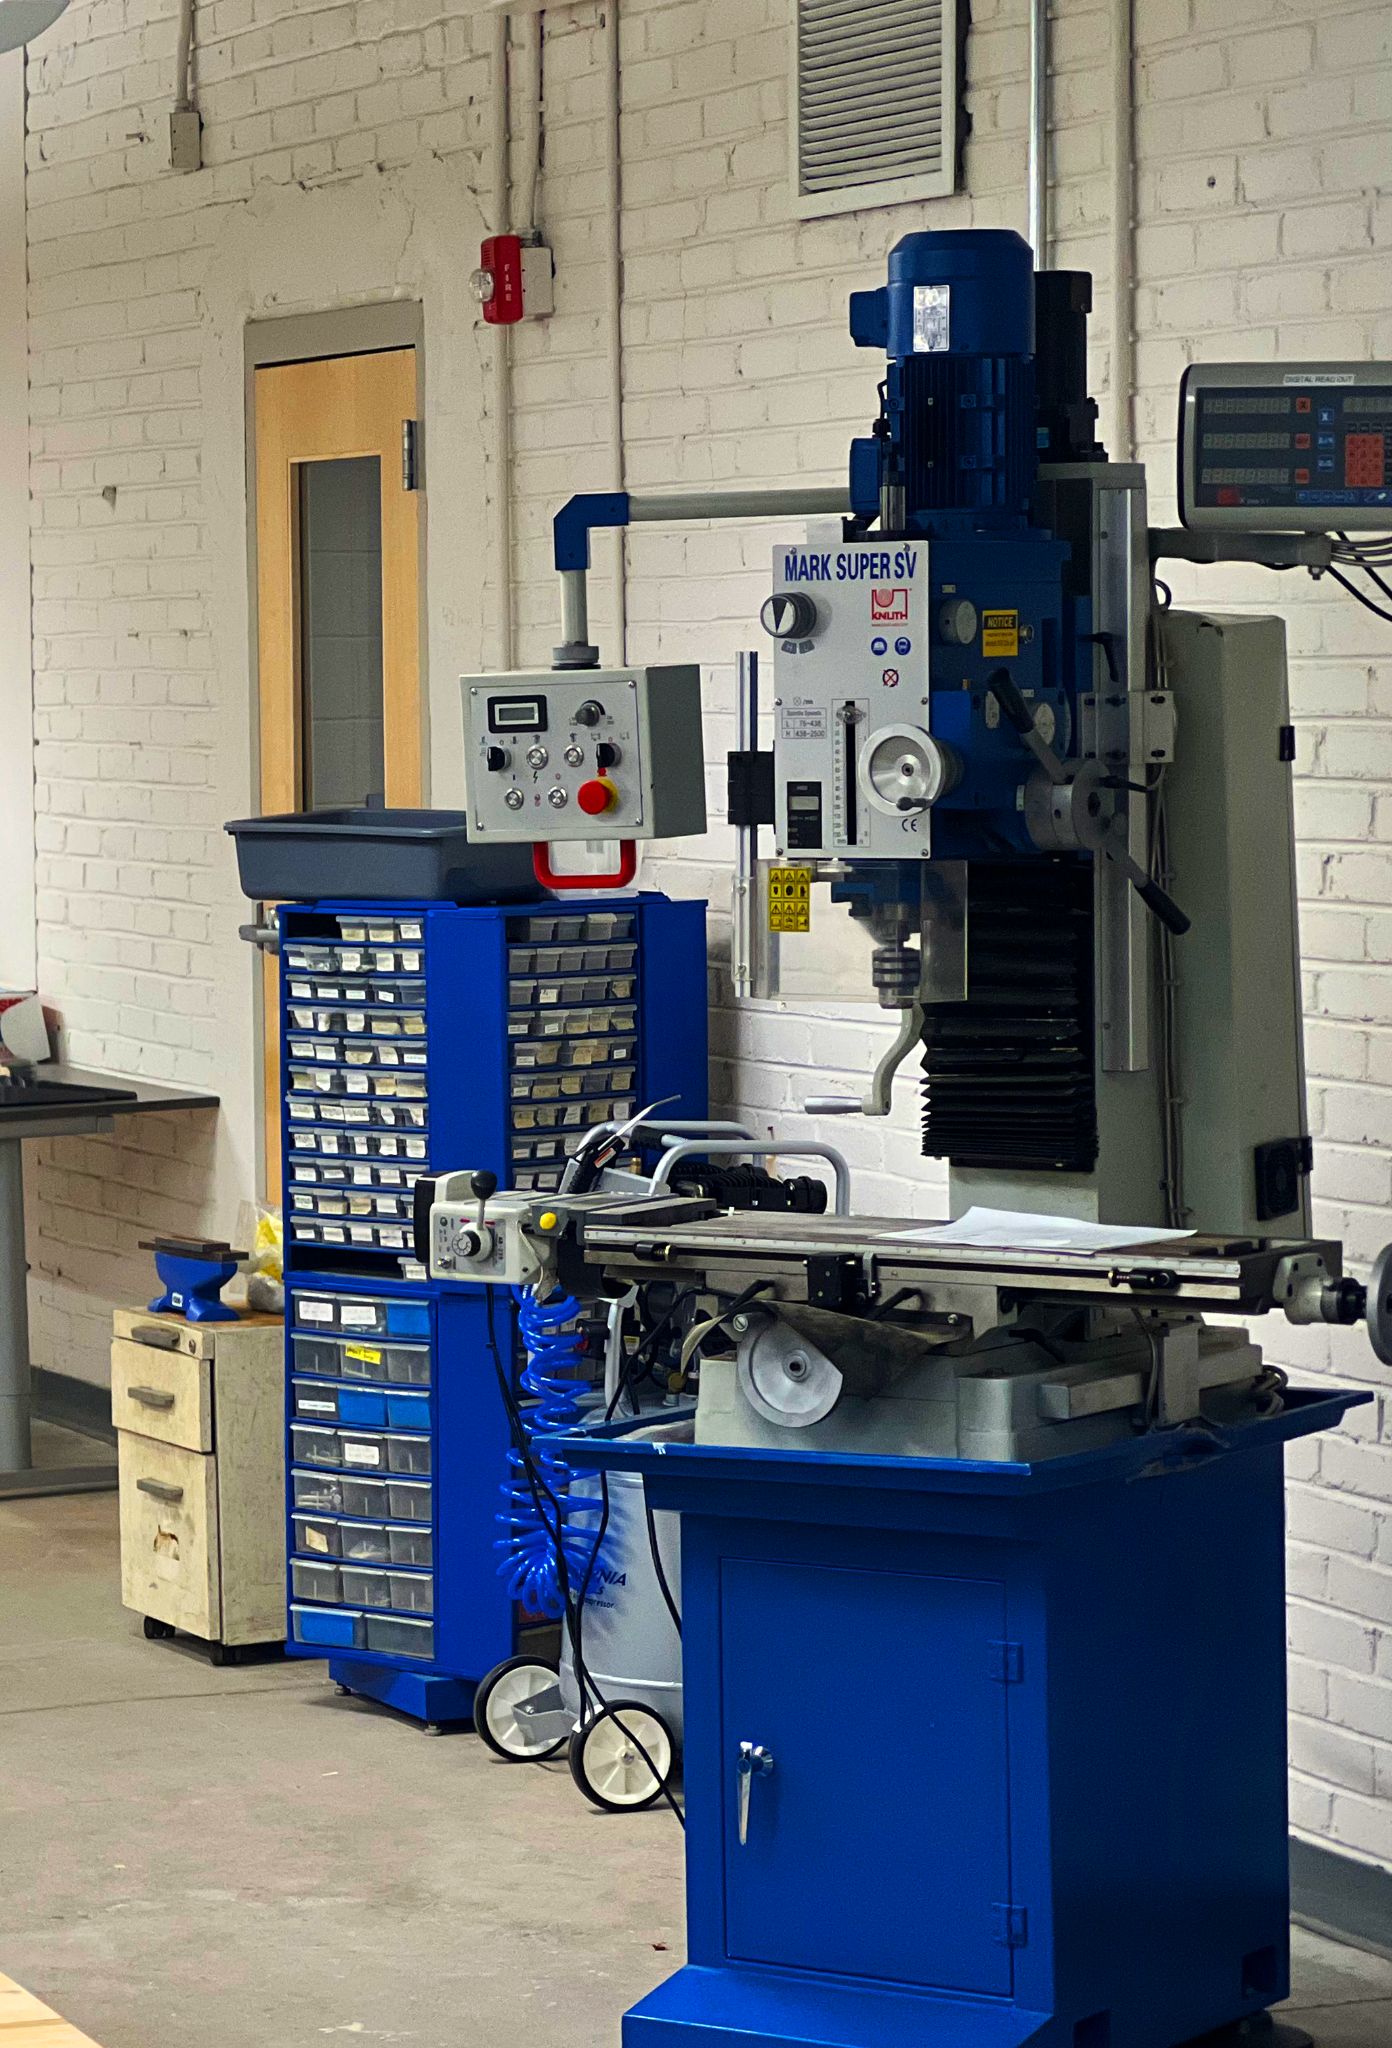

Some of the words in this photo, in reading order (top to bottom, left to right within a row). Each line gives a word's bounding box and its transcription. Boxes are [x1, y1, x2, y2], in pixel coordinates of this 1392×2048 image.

[504, 264, 512, 301] FIRE
[785, 554, 831, 581] MARK
[836, 553, 890, 580] SUPER
[894, 551, 917, 578] SV
[987, 616, 1014, 628] NOTICE
